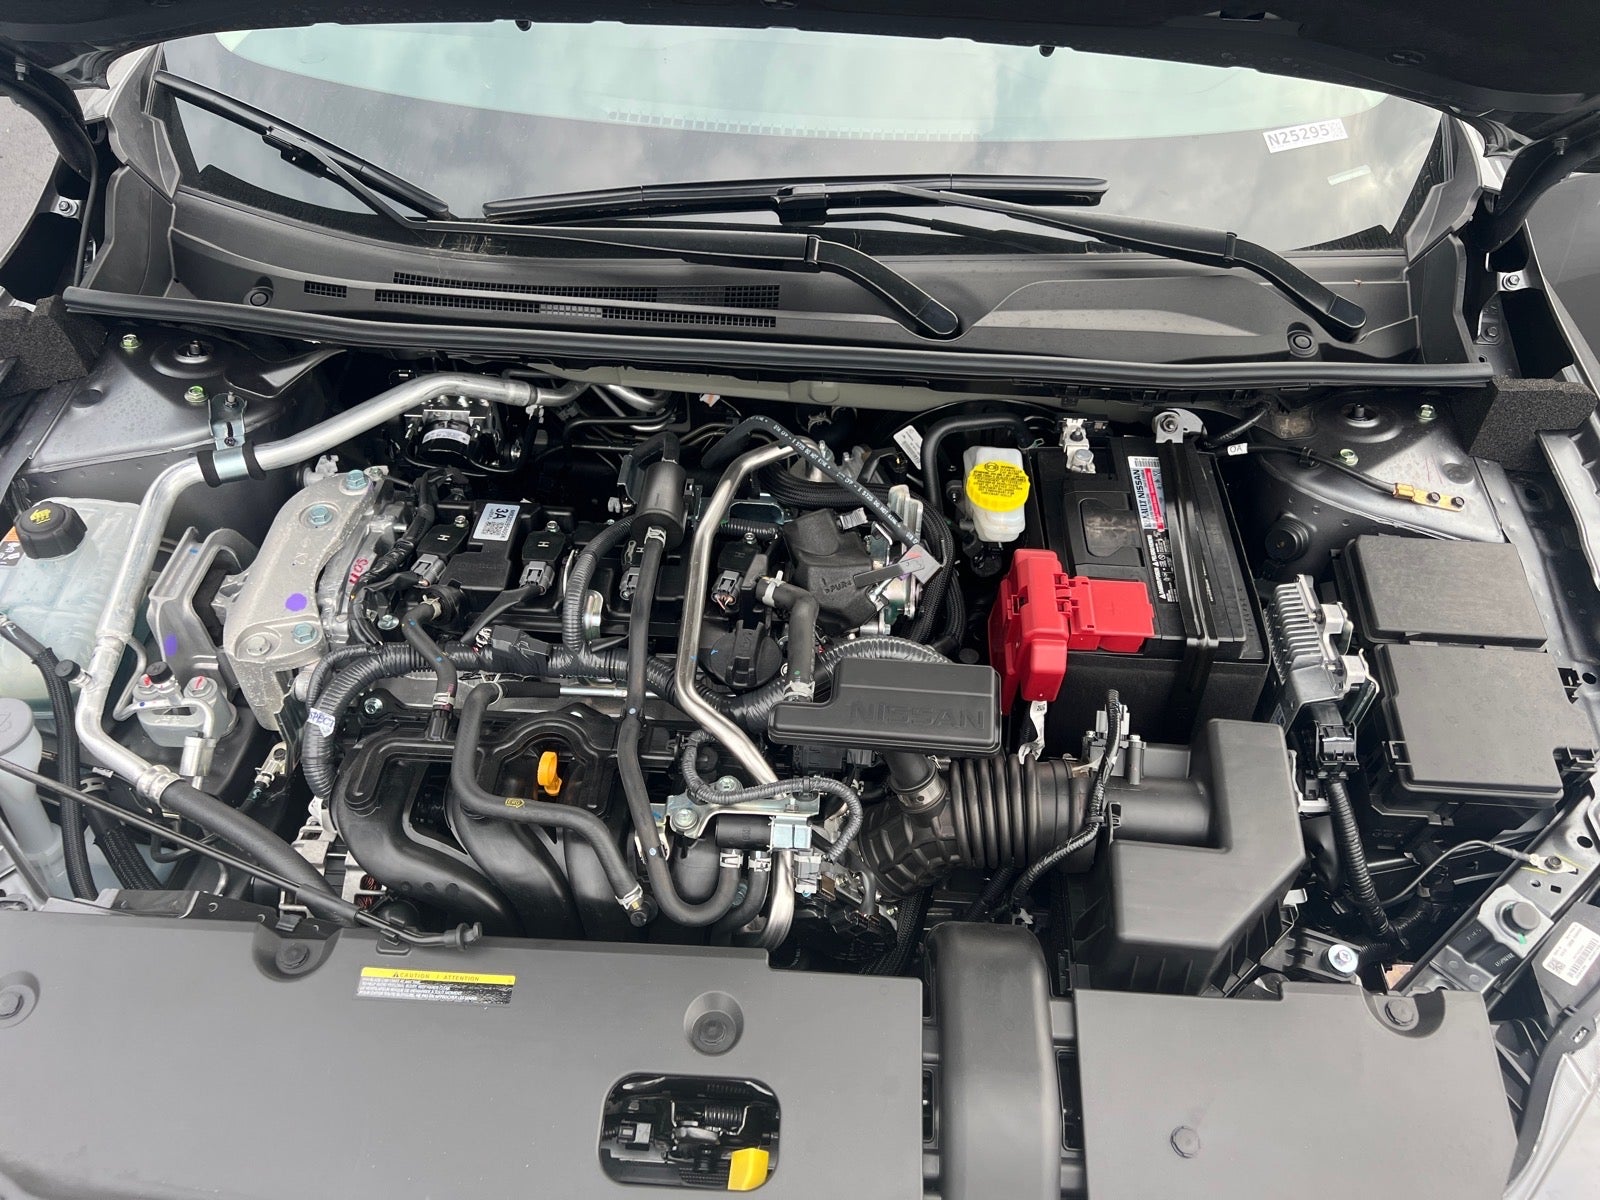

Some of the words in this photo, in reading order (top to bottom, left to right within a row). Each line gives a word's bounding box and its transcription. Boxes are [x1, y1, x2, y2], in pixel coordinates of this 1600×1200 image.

[1267, 124, 1329, 146] N25295
[1133, 469, 1145, 498] NISSAN
[494, 508, 509, 519] 3A
[850, 701, 985, 730] NISSAN
[443, 974, 480, 982] ATTENTION
